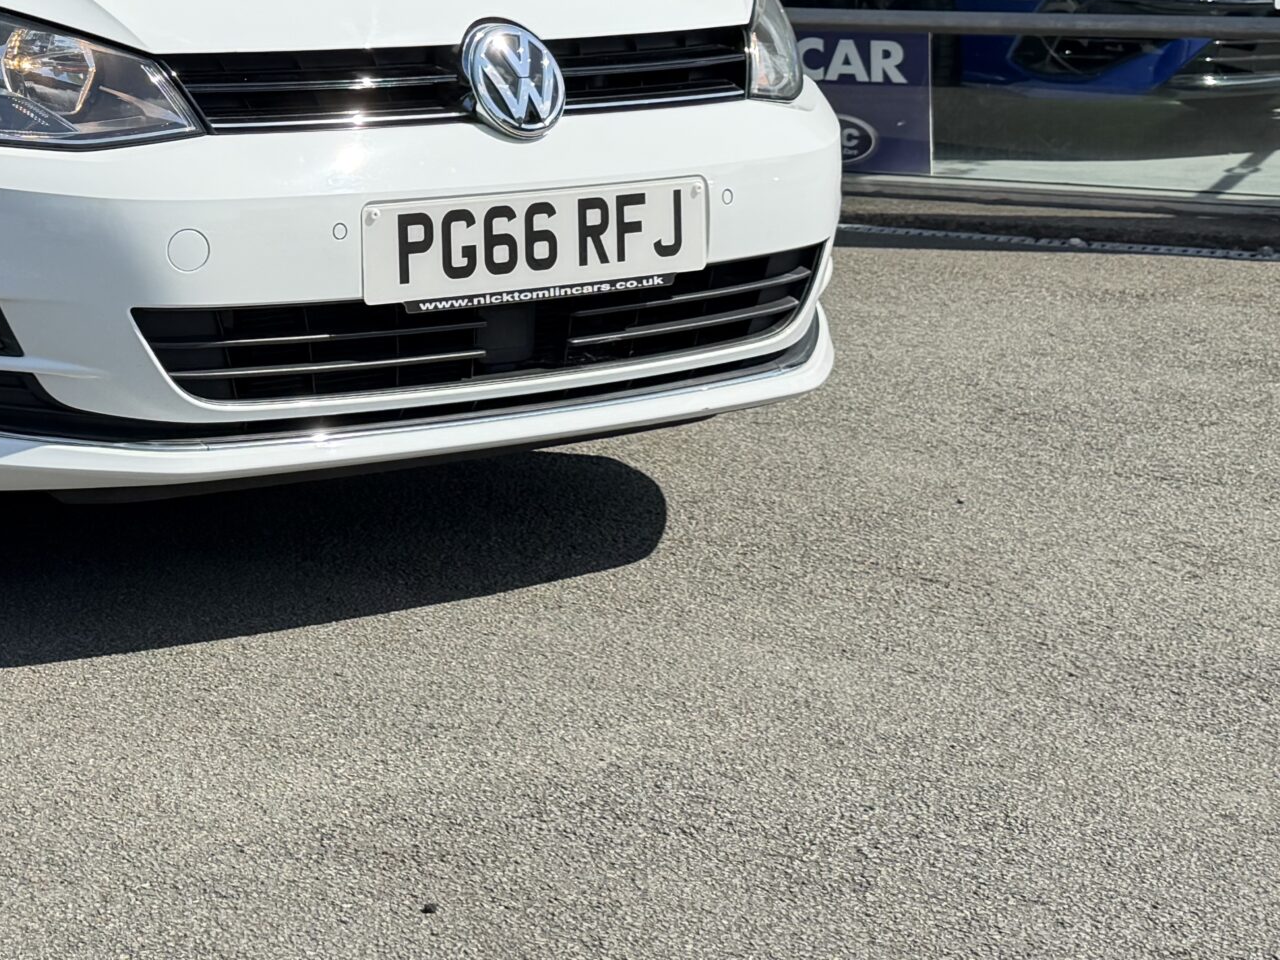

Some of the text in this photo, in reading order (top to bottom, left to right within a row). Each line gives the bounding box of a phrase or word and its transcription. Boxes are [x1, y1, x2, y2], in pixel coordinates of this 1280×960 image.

[796, 37, 908, 84] CAR
[397, 189, 682, 285] PG66 RFJ
[419, 275, 664, 311] www.nicktomlincars.co.uk
